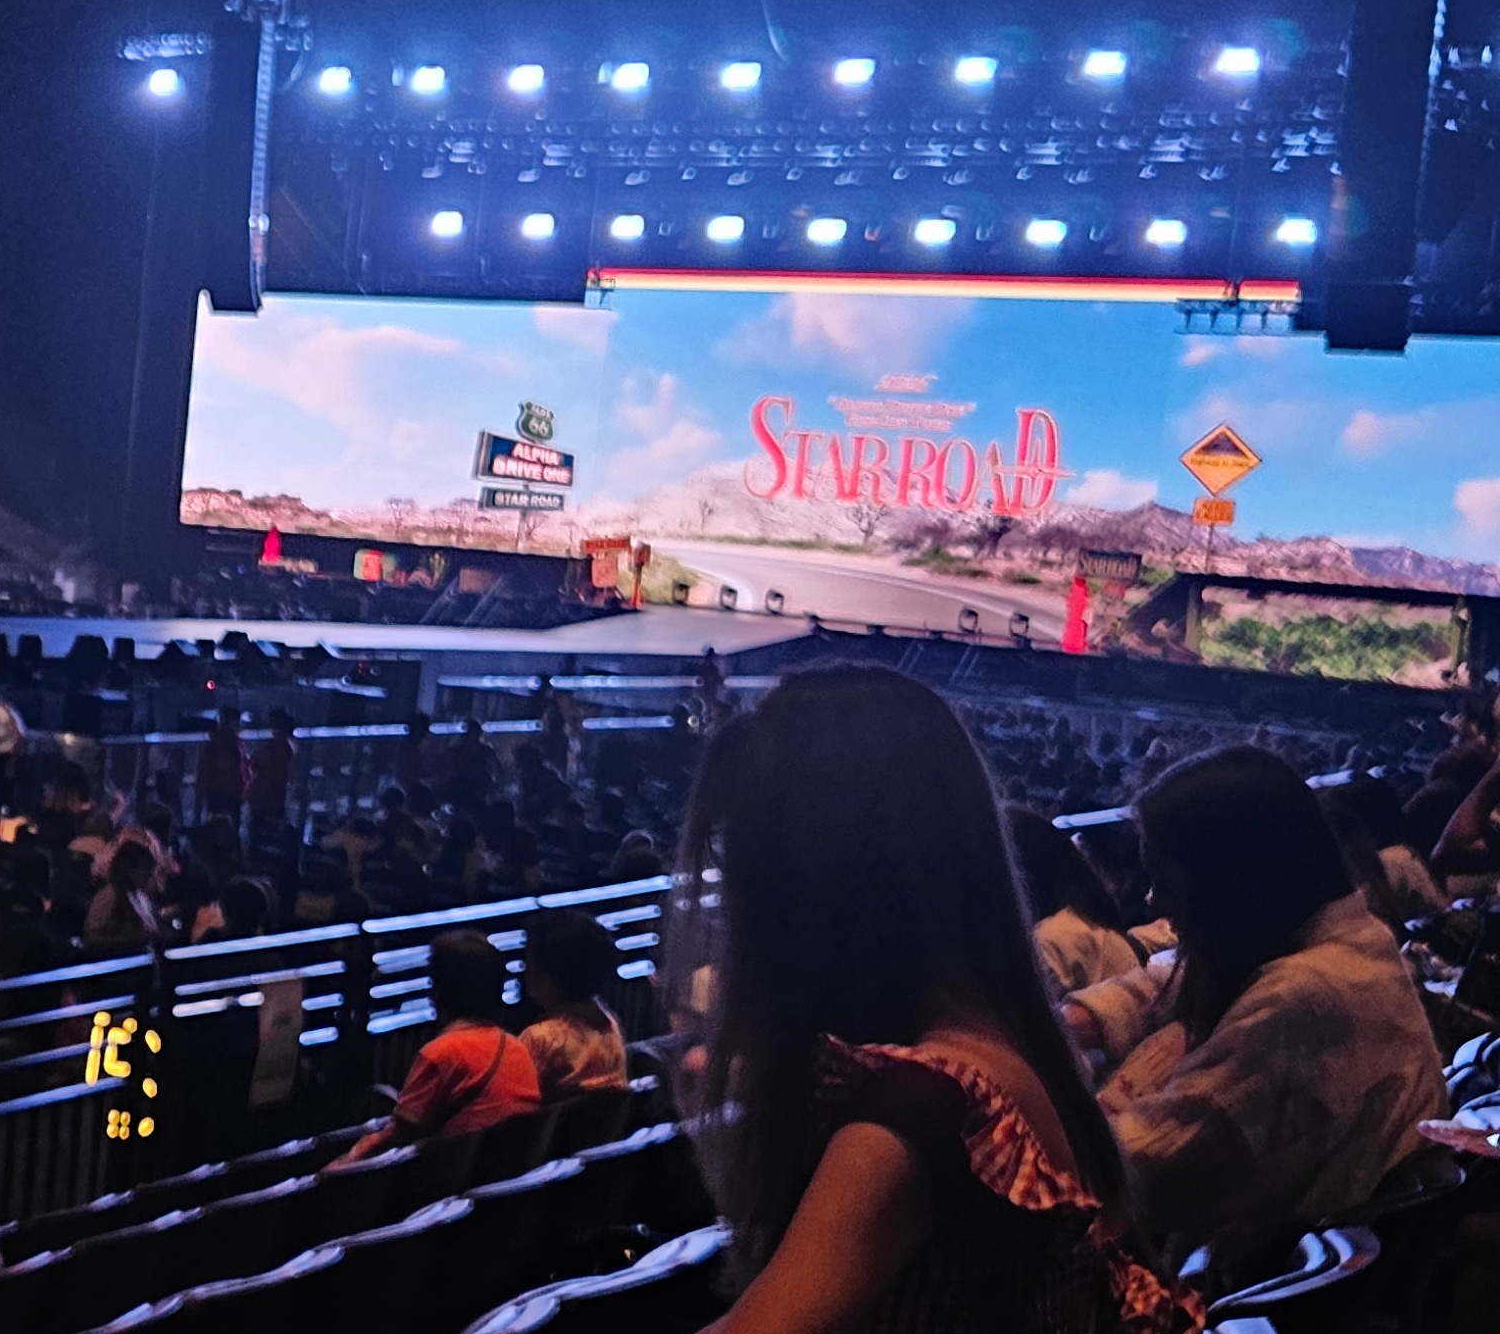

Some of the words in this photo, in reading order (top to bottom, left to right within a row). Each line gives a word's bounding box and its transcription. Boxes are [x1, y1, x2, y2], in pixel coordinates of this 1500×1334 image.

[529, 417, 550, 437] 66
[511, 442, 560, 466] ALPHA
[492, 454, 543, 479] DRIVE
[543, 466, 572, 484] ONE
[494, 491, 529, 507] STAR
[529, 493, 561, 508] ROAD
